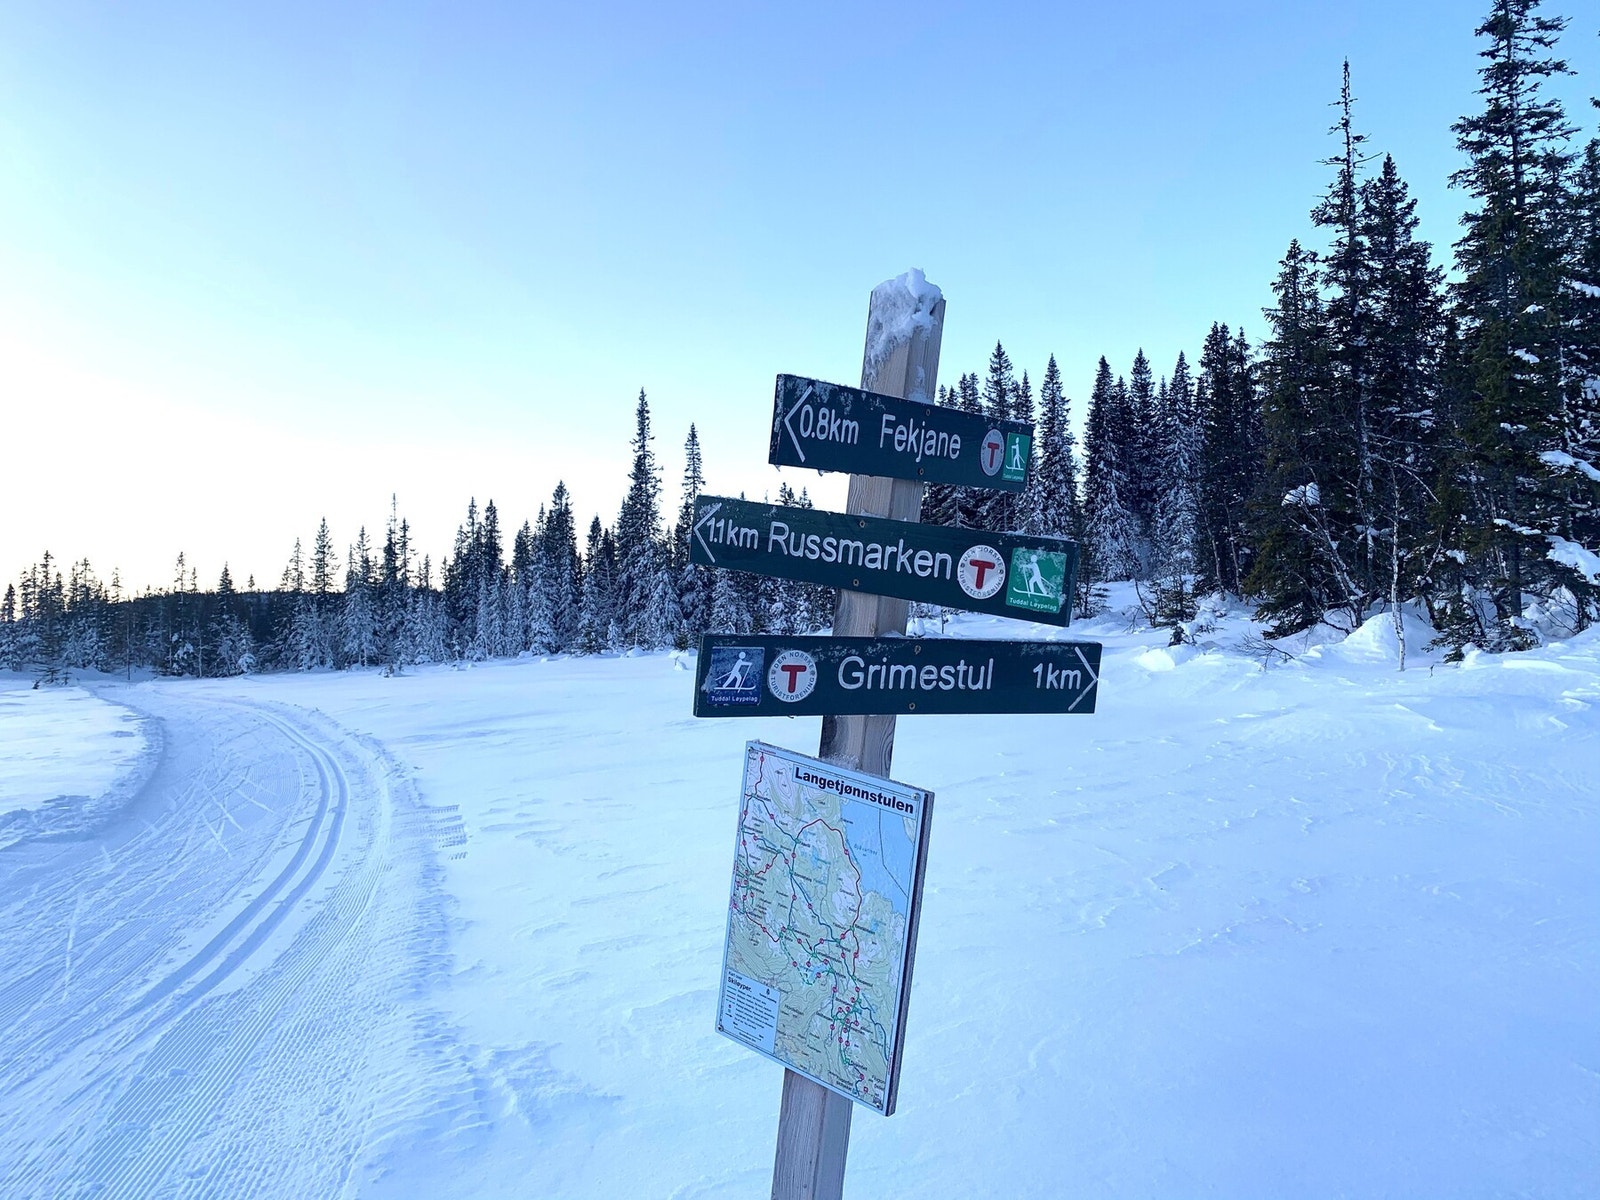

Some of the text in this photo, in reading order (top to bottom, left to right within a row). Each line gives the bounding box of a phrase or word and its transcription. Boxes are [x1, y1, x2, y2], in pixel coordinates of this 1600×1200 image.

[799, 405, 961, 464] 0.8km Fekjane
[706, 517, 952, 580] 1.1km Russmarken
[969, 558, 996, 590] T
[1009, 597, 1029, 607] Tuddal
[780, 664, 807, 694] T
[837, 655, 1082, 691] Grimestul 1km
[795, 767, 914, 814] Langetjønnstulen
